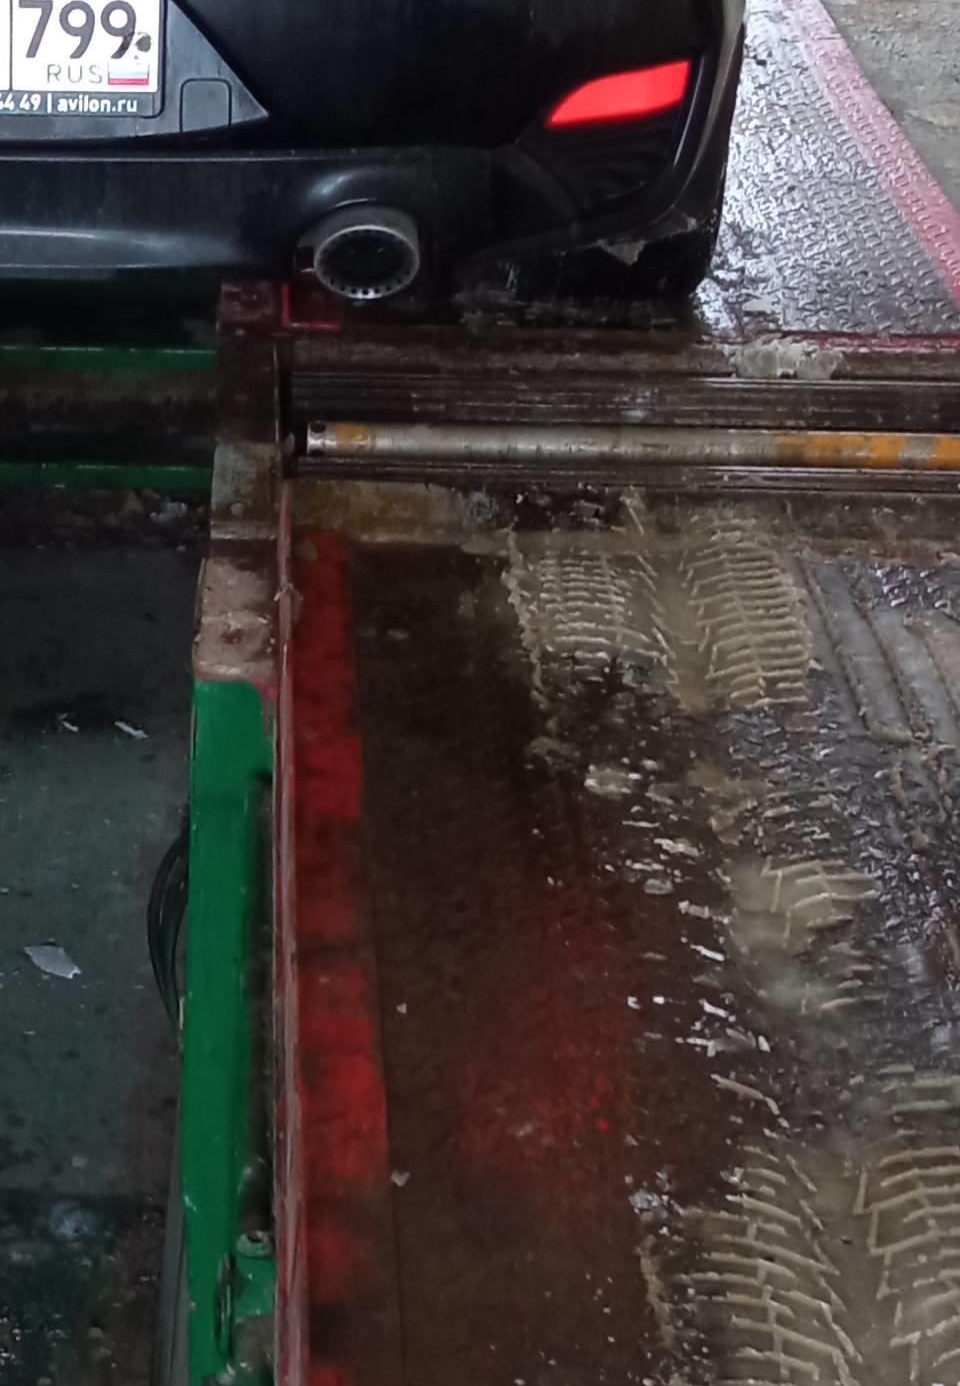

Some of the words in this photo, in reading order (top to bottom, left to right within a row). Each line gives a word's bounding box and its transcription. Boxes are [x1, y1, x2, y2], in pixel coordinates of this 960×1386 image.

[18, 0, 137, 59] 799
[46, 63, 103, 84] RUS
[19, 93, 41, 111] 49
[57, 95, 138, 113] avilon.ru
